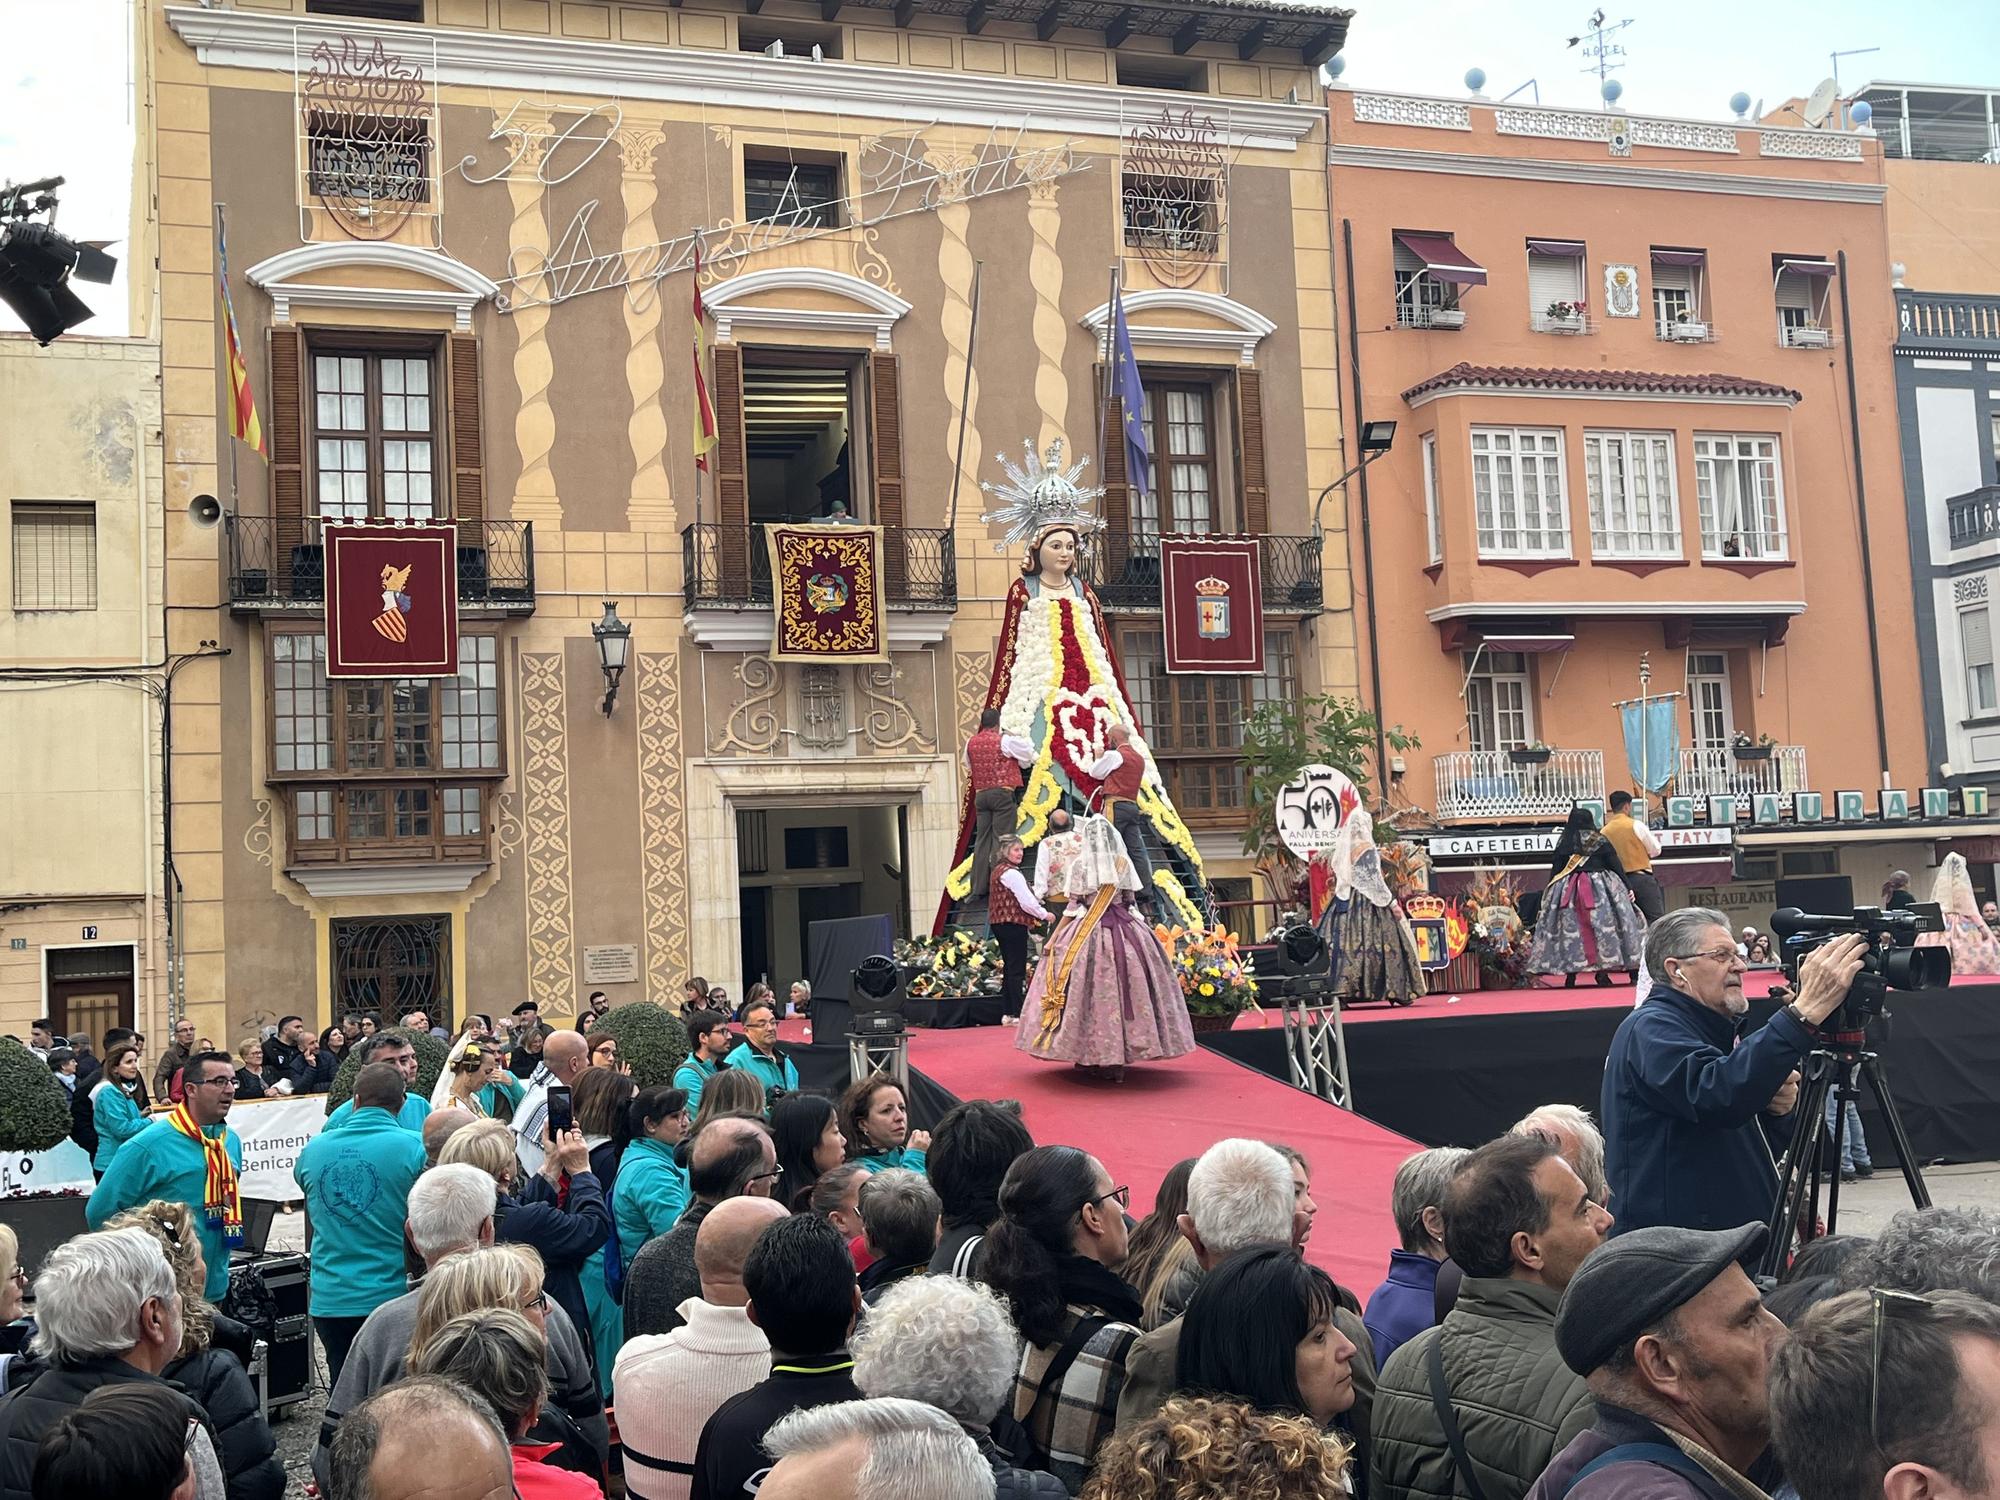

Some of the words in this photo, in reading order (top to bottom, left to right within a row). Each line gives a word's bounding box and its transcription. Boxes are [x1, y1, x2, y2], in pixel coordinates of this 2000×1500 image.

[1583, 44, 1627, 57] HOTEL
[460, 99, 622, 185] 50
[1280, 769, 1341, 830] 50
[1672, 831, 1713, 844] FATY
[1688, 891, 1776, 907] RESTAURANT
[82, 927, 97, 939] 12
[242, 1133, 312, 1153] ntament
[240, 1156, 299, 1173] Benica
